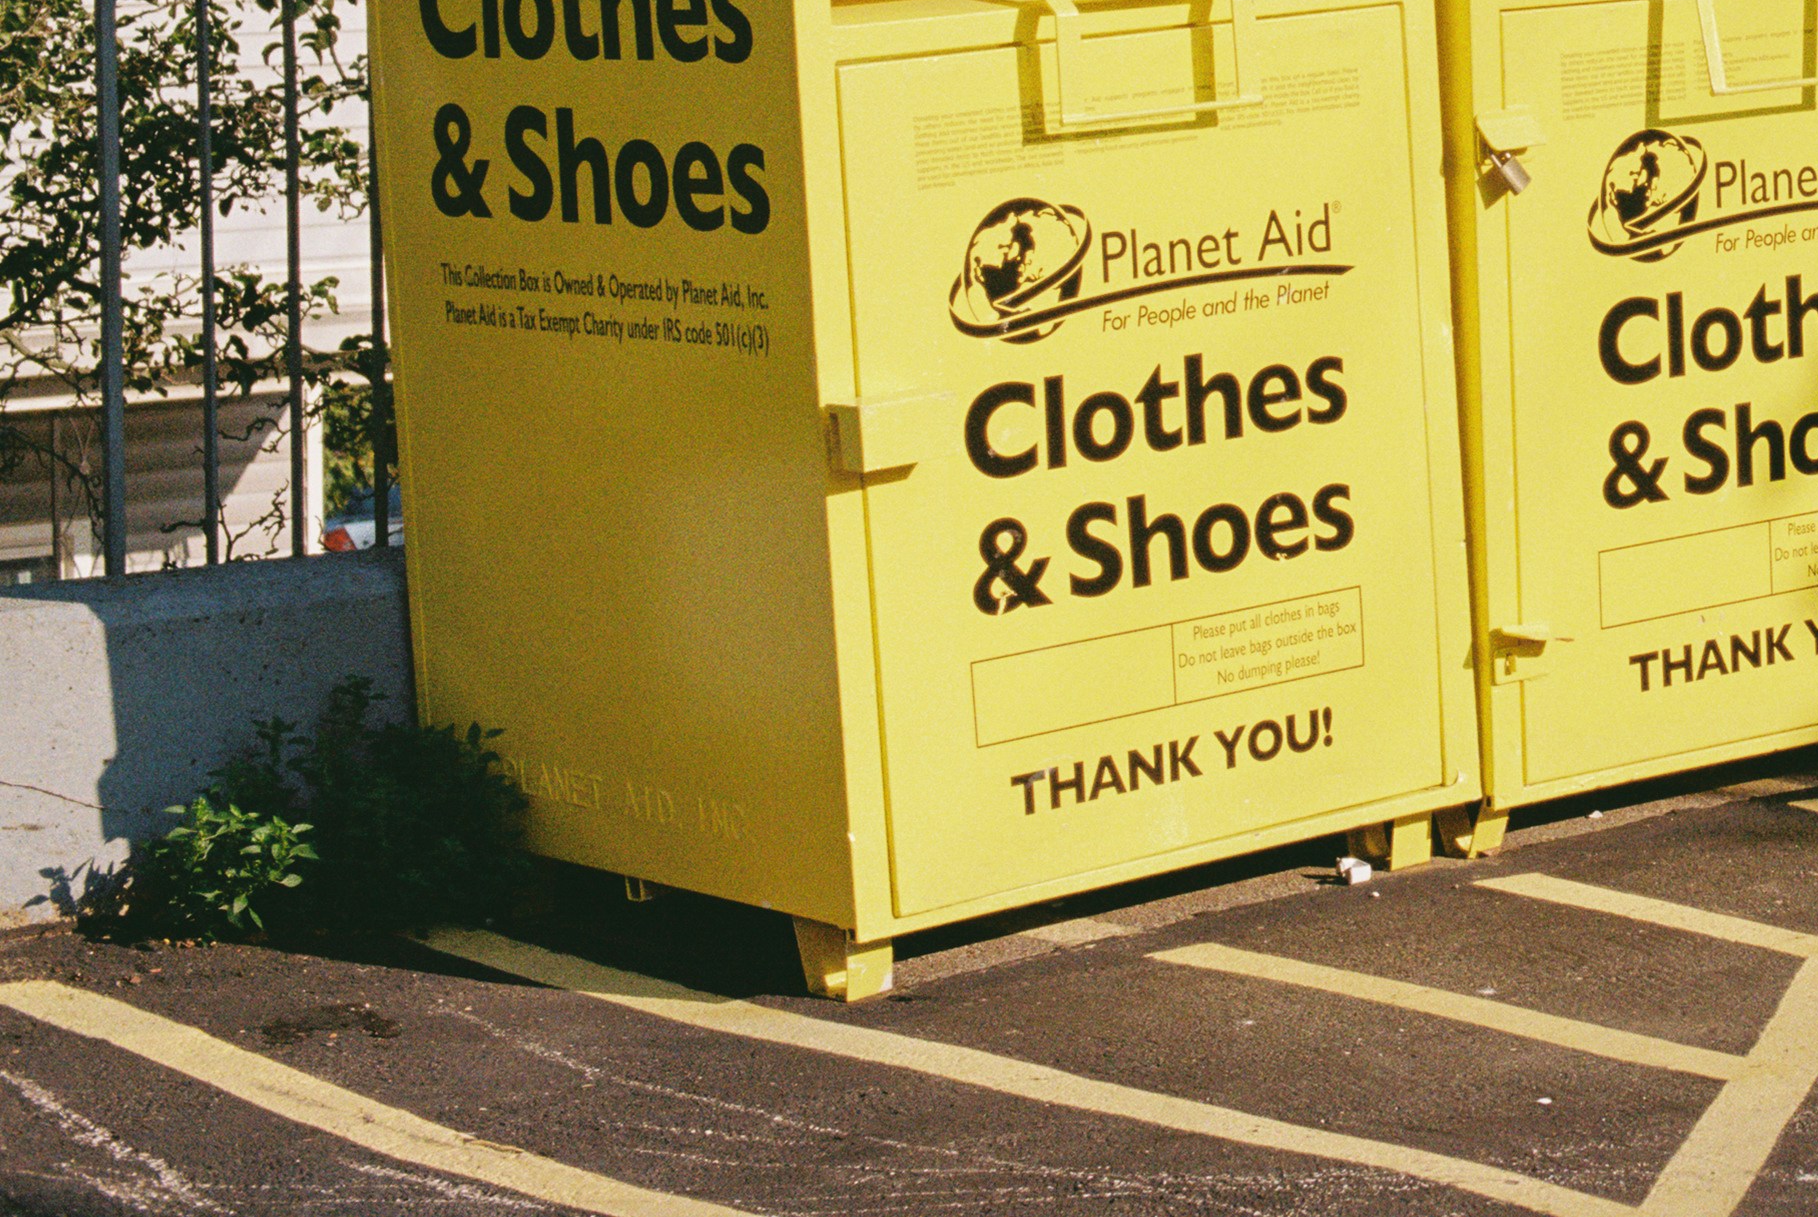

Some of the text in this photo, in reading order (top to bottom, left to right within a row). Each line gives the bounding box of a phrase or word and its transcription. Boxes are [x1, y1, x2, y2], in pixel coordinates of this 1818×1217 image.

[1101, 227, 1241, 283] Planet
[1716, 233, 1740, 254] For
[1746, 224, 1796, 251] People
[441, 262, 768, 311] This Collection Box is Owned & Operated by Planet Aid, Inc.
[1103, 281, 1330, 332] For People and the Planet
[445, 301, 769, 357] Planet Aid is a Tax Exempt Charity under IRS code 501(c)(3)
[964, 352, 1348, 480] Clothes
[1788, 522, 1815, 536] Please
[1775, 547, 1789, 562] Do
[1792, 546, 1808, 557] not
[1178, 623, 1357, 668] Do not leave bags outside the box
[1193, 602, 1340, 640] Please put all clothes in bags
[1217, 650, 1320, 685] No dumping please!
[1629, 623, 1794, 692] THANK
[1010, 706, 1334, 816] THANK YOU!
